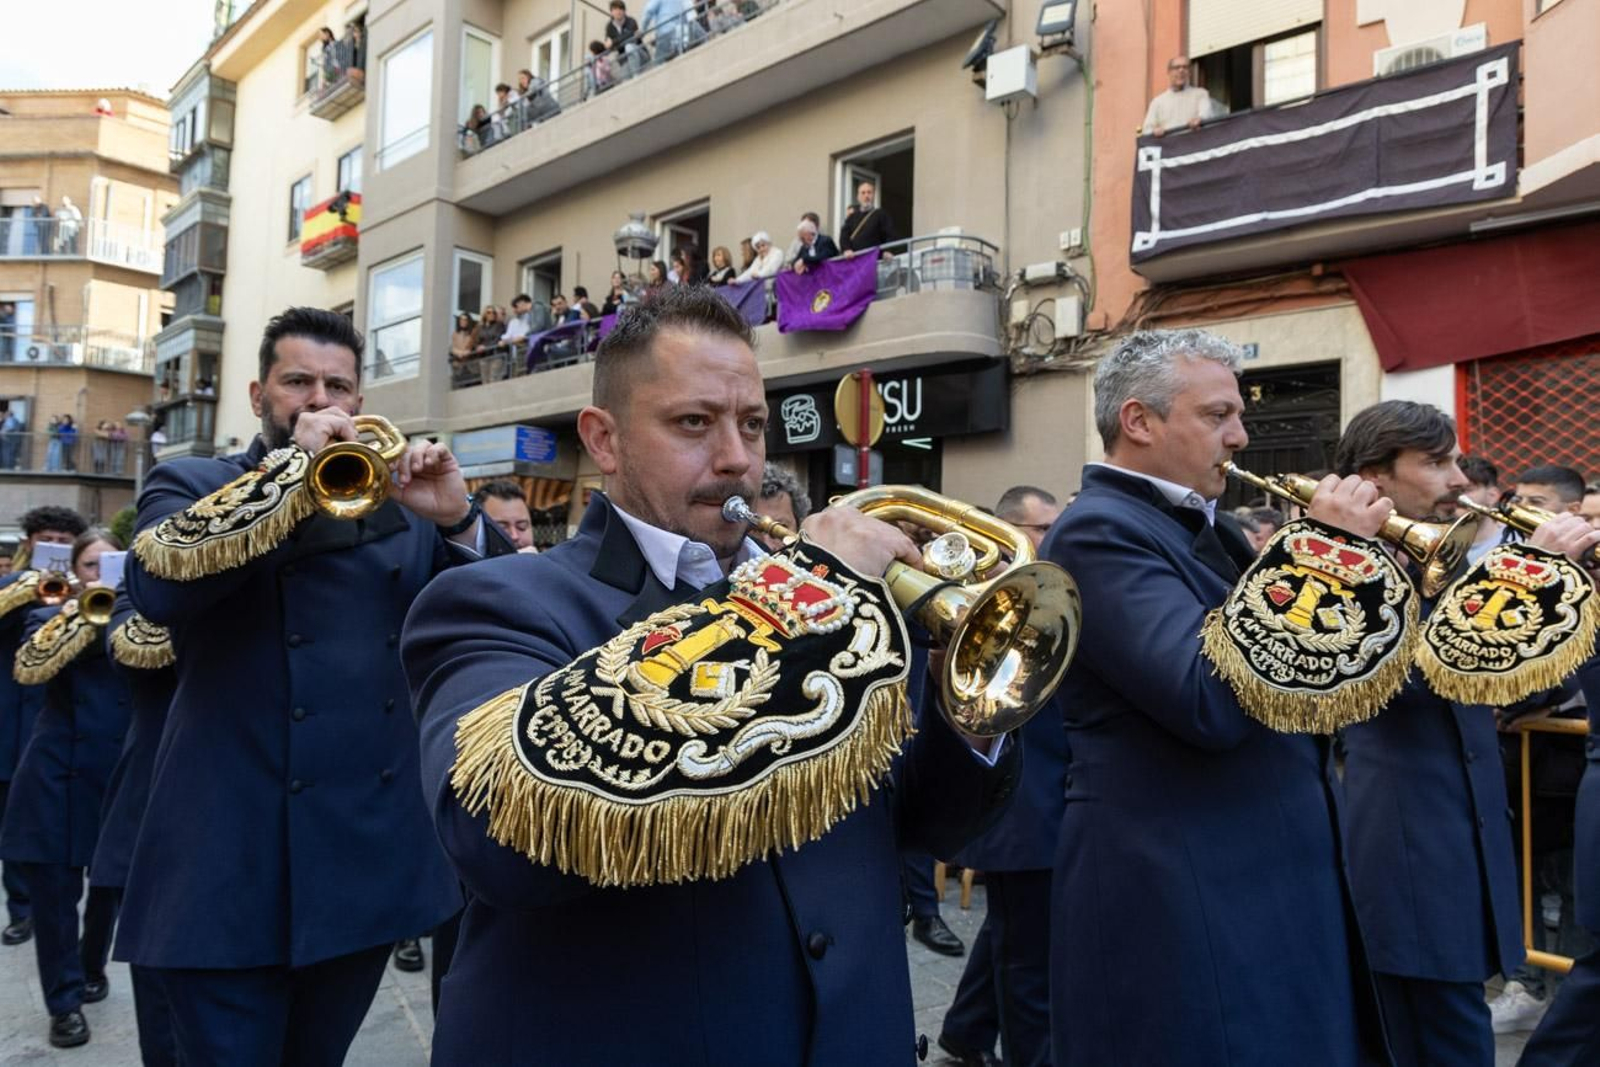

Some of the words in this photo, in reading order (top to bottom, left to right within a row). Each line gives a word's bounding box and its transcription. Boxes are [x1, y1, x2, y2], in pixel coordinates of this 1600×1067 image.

[878, 377, 923, 424] SU
[1250, 384, 1263, 401] 3
[1239, 617, 1334, 671] AMARRADO
[1258, 650, 1289, 677] 1998
